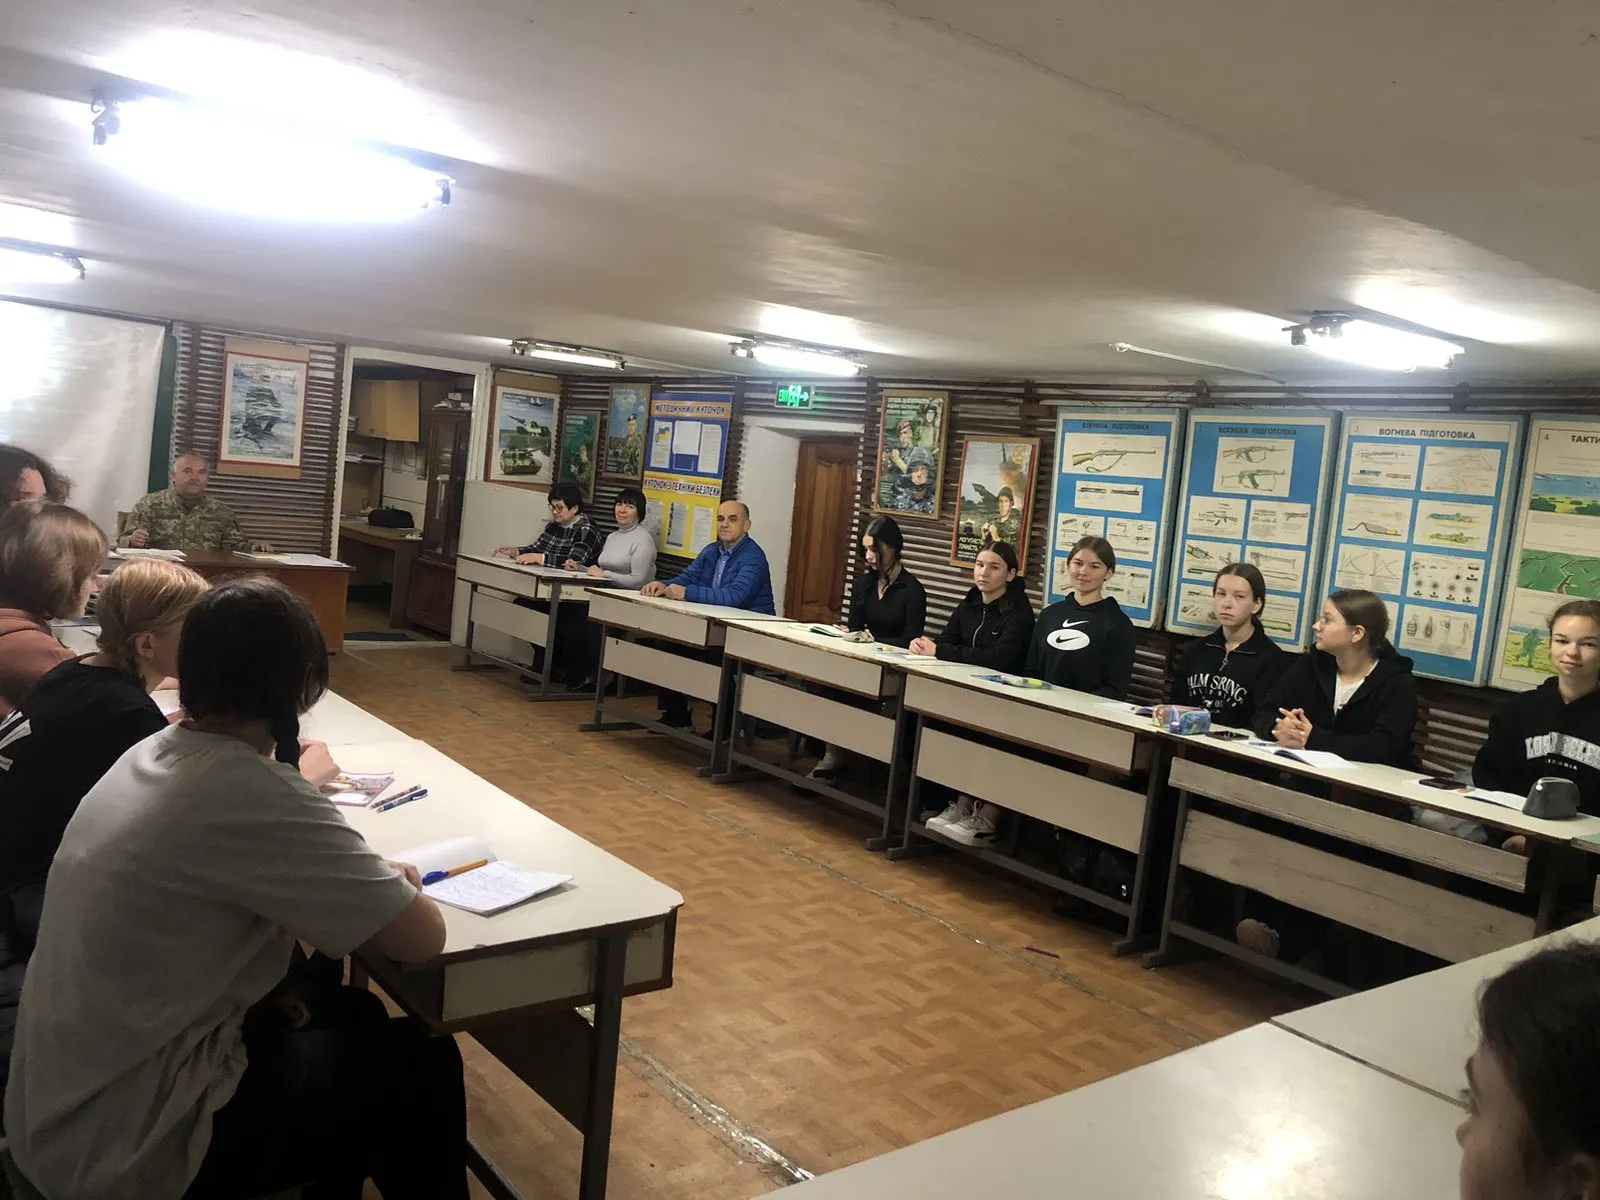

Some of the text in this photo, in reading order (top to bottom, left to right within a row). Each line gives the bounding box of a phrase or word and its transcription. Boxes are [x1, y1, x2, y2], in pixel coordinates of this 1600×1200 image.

[696, 405, 726, 415] КУТОЧОК
[1379, 428, 1476, 440] ВОГНЕВА ПІДГОТОВКА
